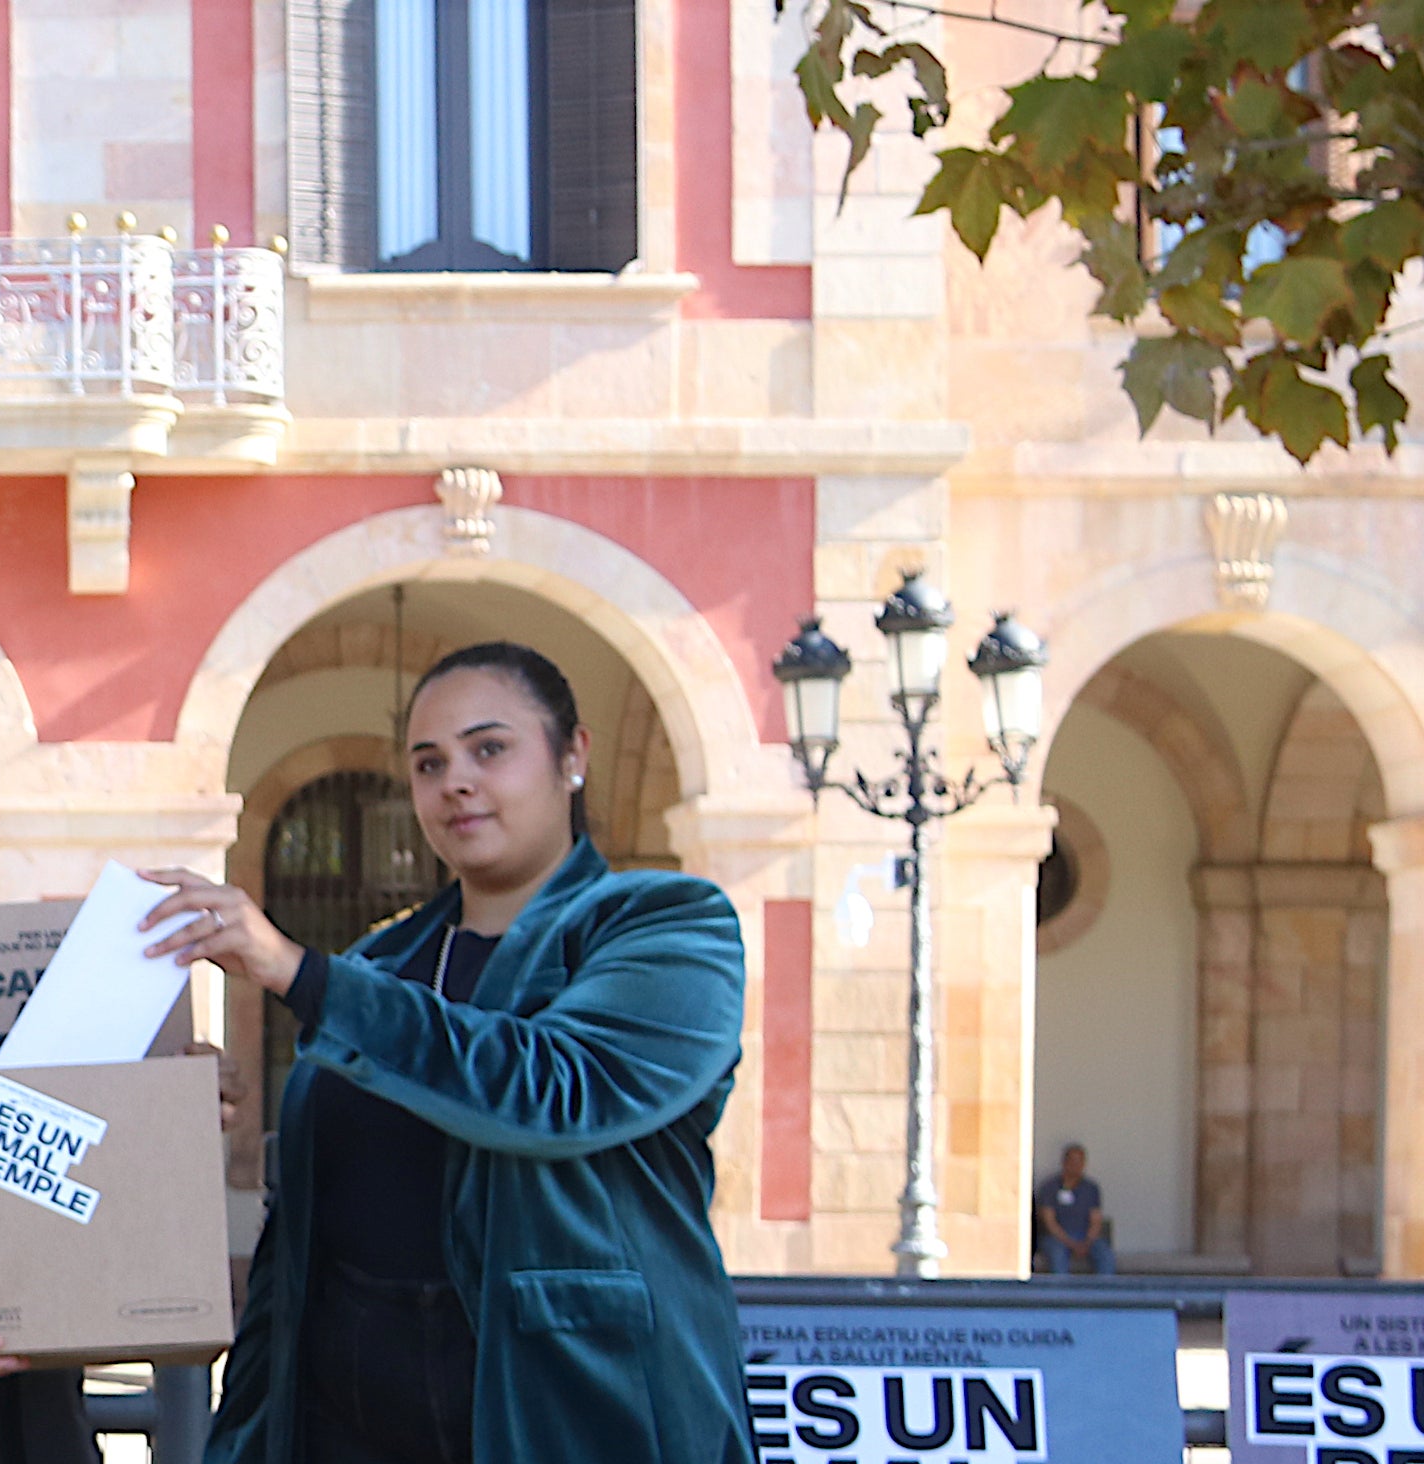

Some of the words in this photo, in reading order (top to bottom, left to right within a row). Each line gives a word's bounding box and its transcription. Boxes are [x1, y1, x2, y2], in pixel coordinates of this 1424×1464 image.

[37, 1121, 83, 1157] UN
[814, 1326, 919, 1344] EDUCATIU
[924, 1327, 968, 1345] QUE
[972, 1327, 1002, 1344] NO
[1007, 1328, 1076, 1347] CUIDA
[795, 1347, 824, 1363] LA
[831, 1347, 896, 1364] SALUT
[903, 1349, 988, 1366] MENTAL
[1254, 1337, 1386, 1438] ÉS
[883, 1376, 1038, 1452] UN
